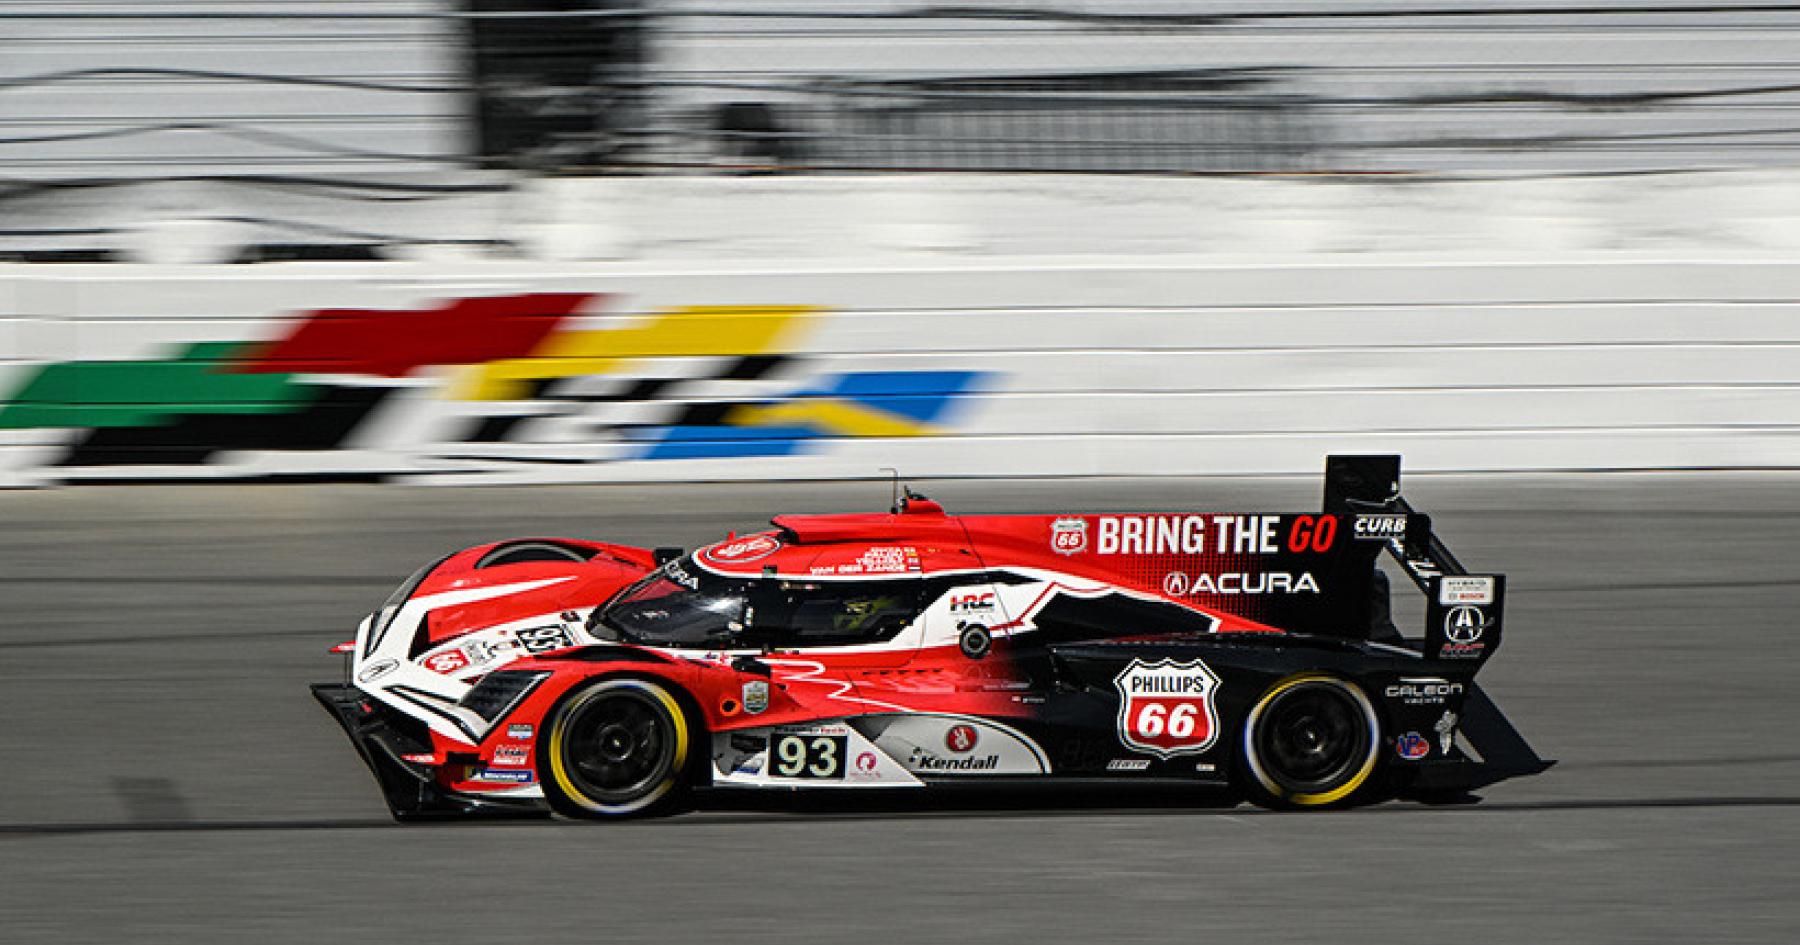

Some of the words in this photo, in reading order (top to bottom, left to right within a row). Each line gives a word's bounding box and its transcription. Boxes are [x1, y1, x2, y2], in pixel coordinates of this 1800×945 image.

[1097, 516, 1205, 554] BRING
[1213, 516, 1281, 554] THE
[1287, 514, 1338, 553] GO
[1354, 517, 1407, 533] CURB
[1057, 533, 1081, 546] 66
[1190, 572, 1320, 594] ACURA
[950, 592, 996, 612] HRC
[1132, 676, 1204, 692] PHILLIPS
[1385, 683, 1463, 697] GALEON
[1137, 703, 1199, 738] 66
[777, 736, 838, 777] 93
[920, 754, 1000, 770] Kendall
